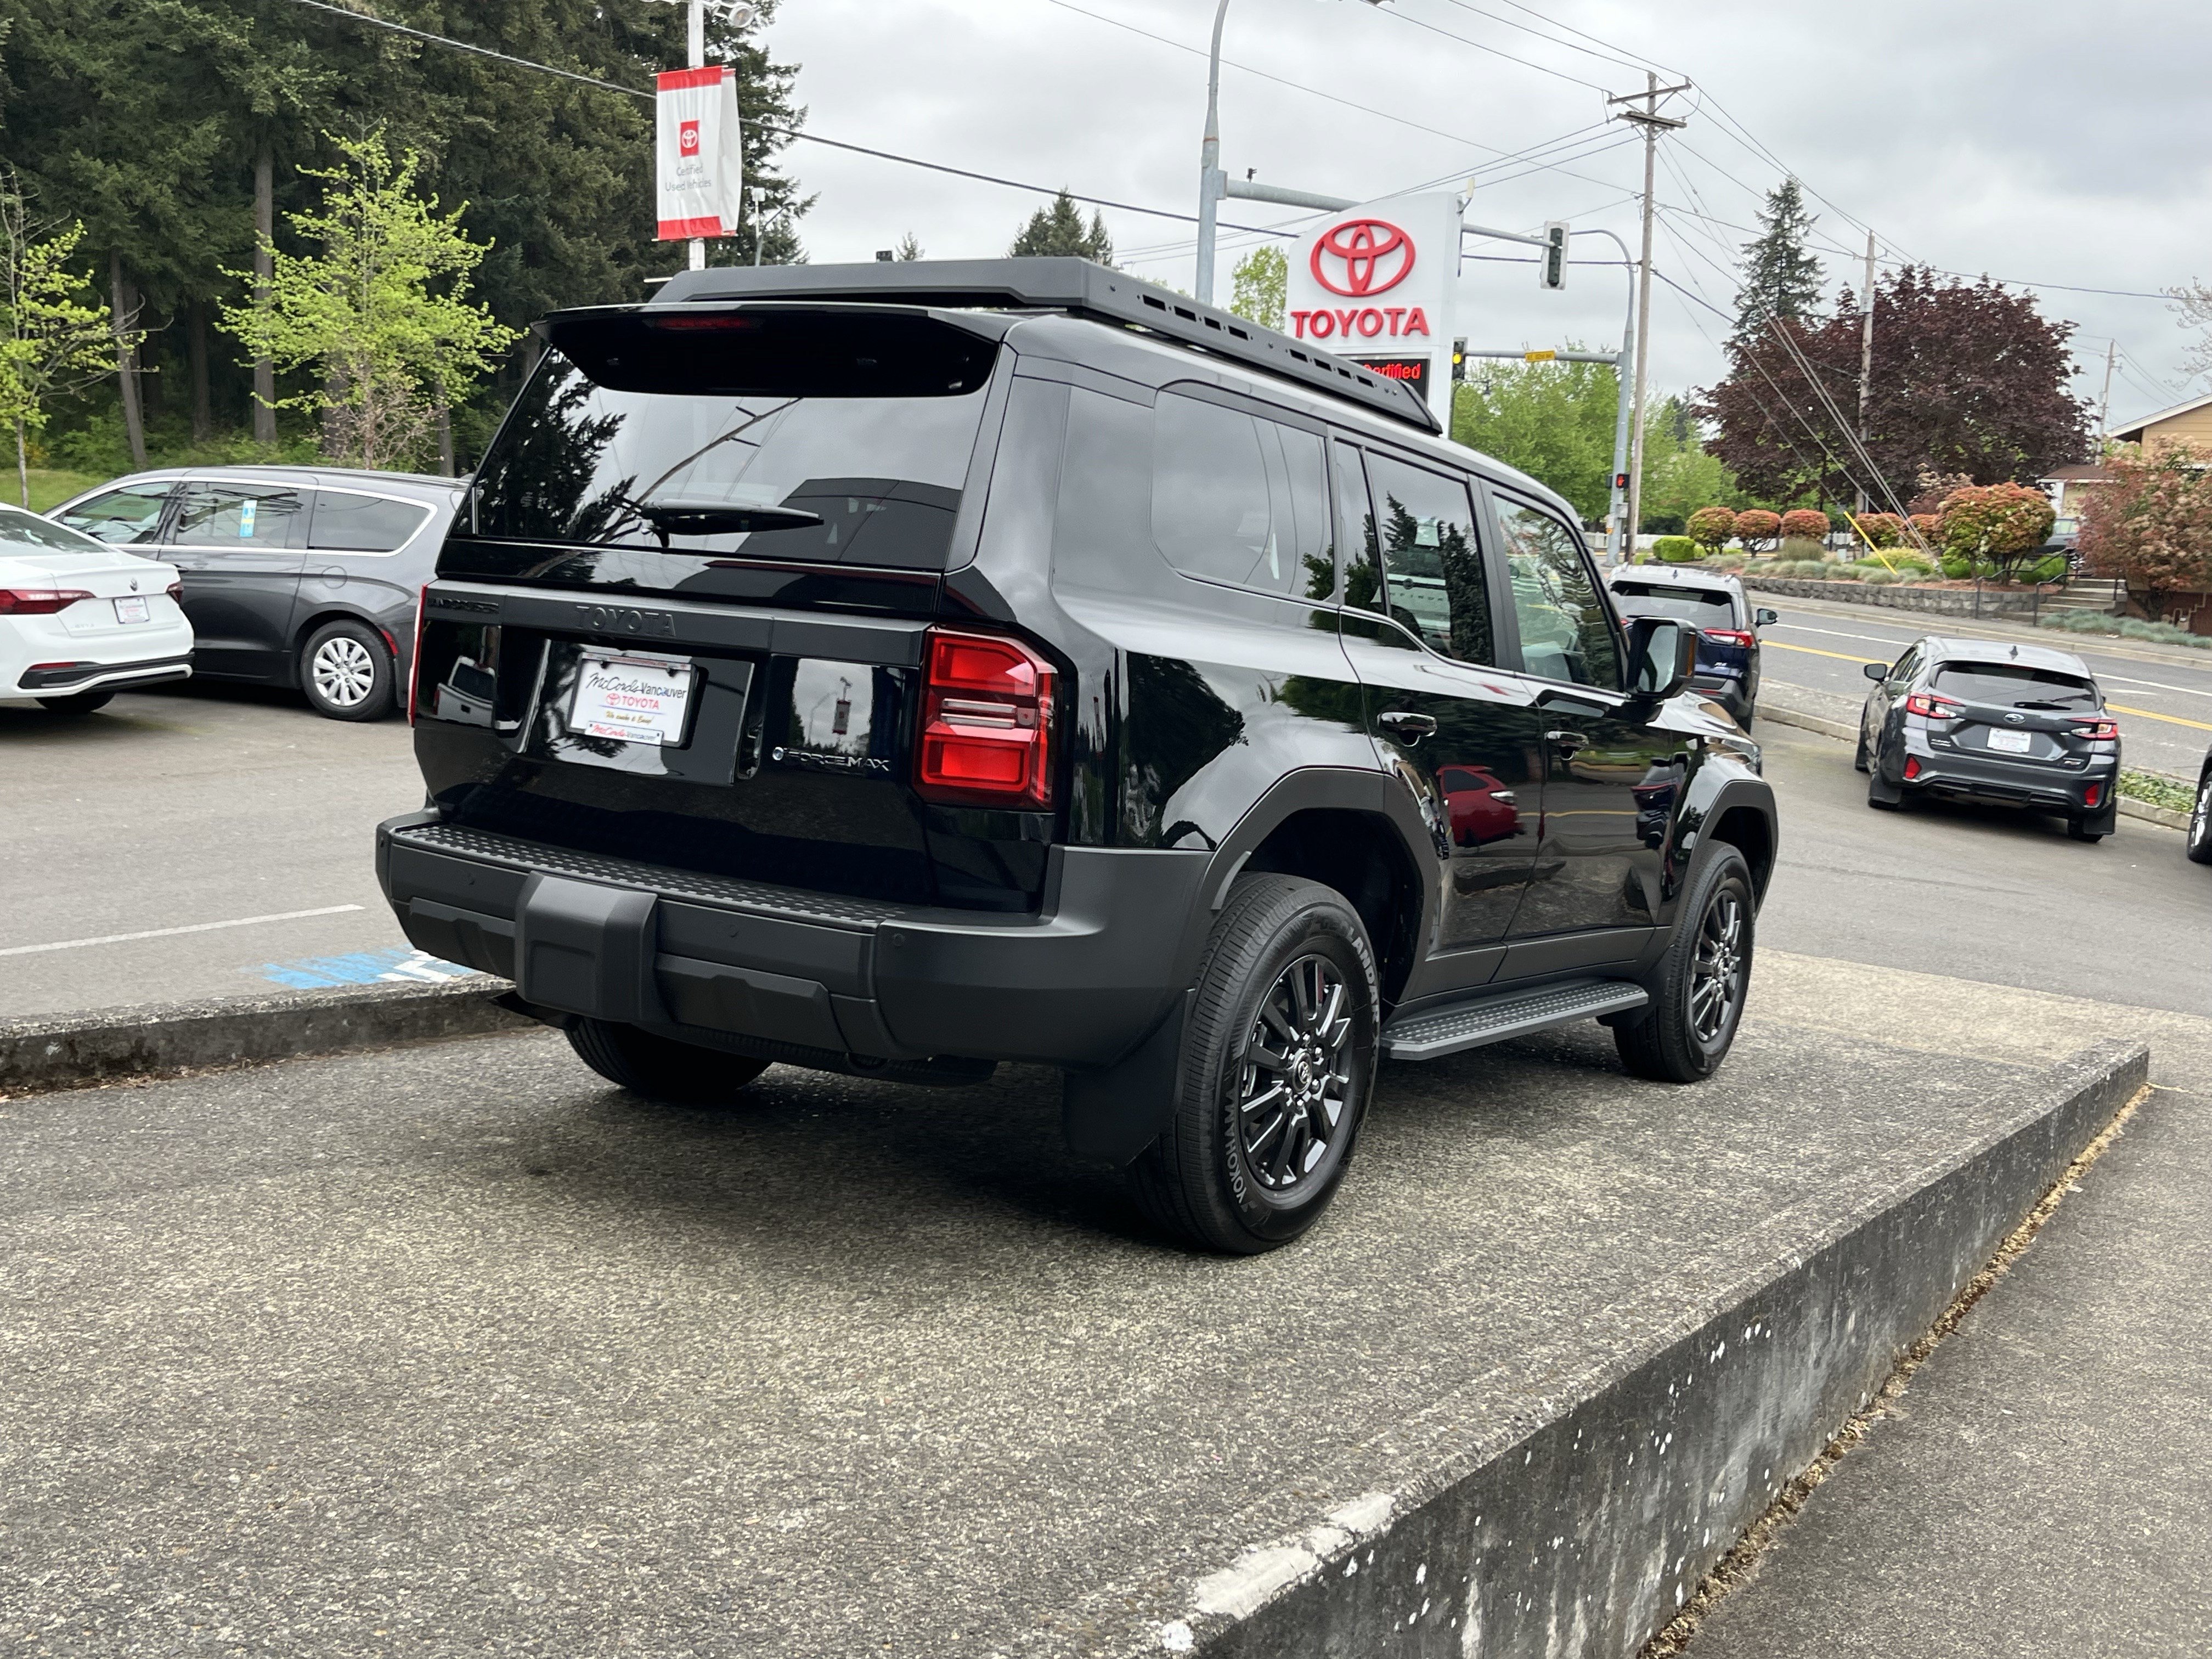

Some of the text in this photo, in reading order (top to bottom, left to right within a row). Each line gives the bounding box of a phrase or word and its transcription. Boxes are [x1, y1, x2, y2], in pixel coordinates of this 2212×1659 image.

[665, 181, 685, 191] Used
[1291, 307, 1430, 339] TOYOTA
[576, 606, 676, 636] TOYOTA
[623, 696, 659, 709] TOYOTA
[847, 756, 890, 771] MAX
[1224, 1087, 1247, 1204] YOKOHAMA
